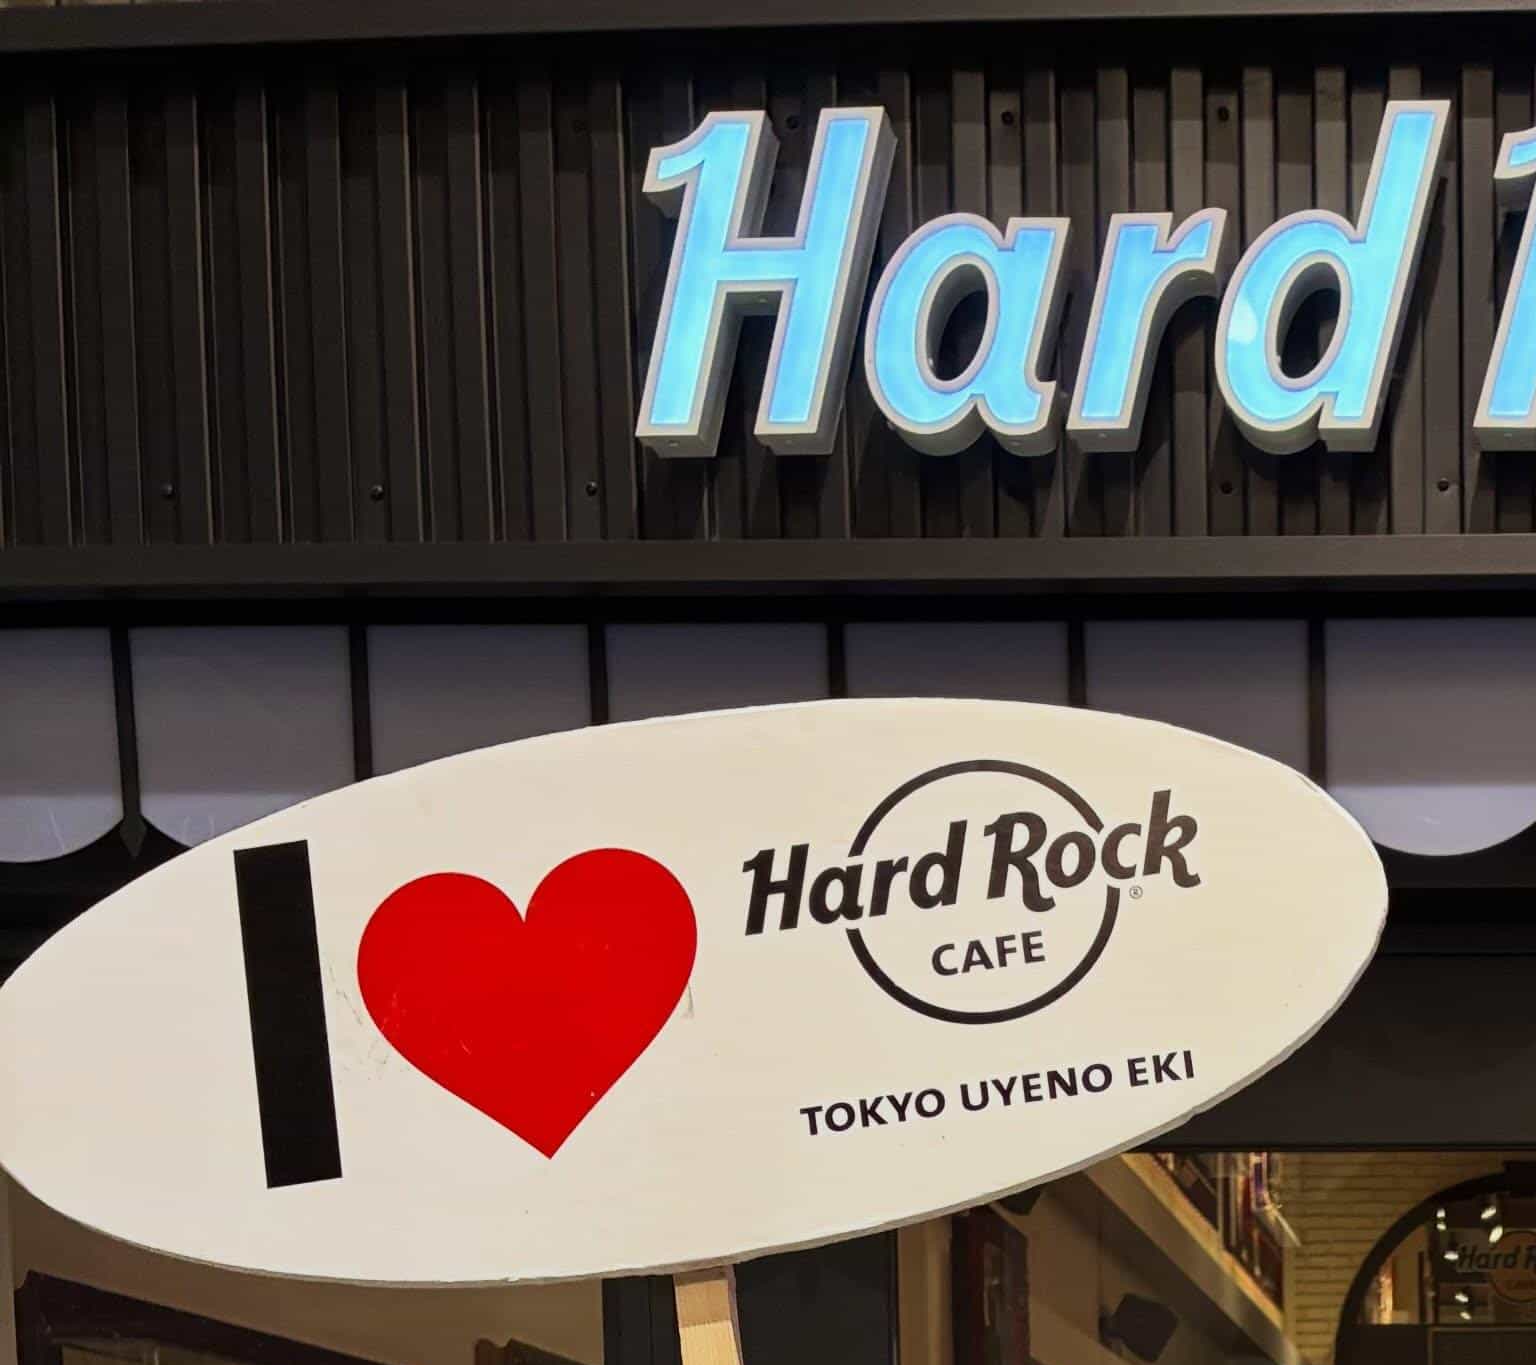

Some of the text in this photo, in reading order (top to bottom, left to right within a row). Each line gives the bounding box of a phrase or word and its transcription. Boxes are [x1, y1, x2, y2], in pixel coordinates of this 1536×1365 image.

[635, 99, 1451, 456] Hard
[742, 788, 1202, 936] Hard Rock
[233, 838, 343, 1190] I
[930, 930, 1046, 977] CAFE
[800, 1049, 1195, 1136] TOKYO UYENO EKI
